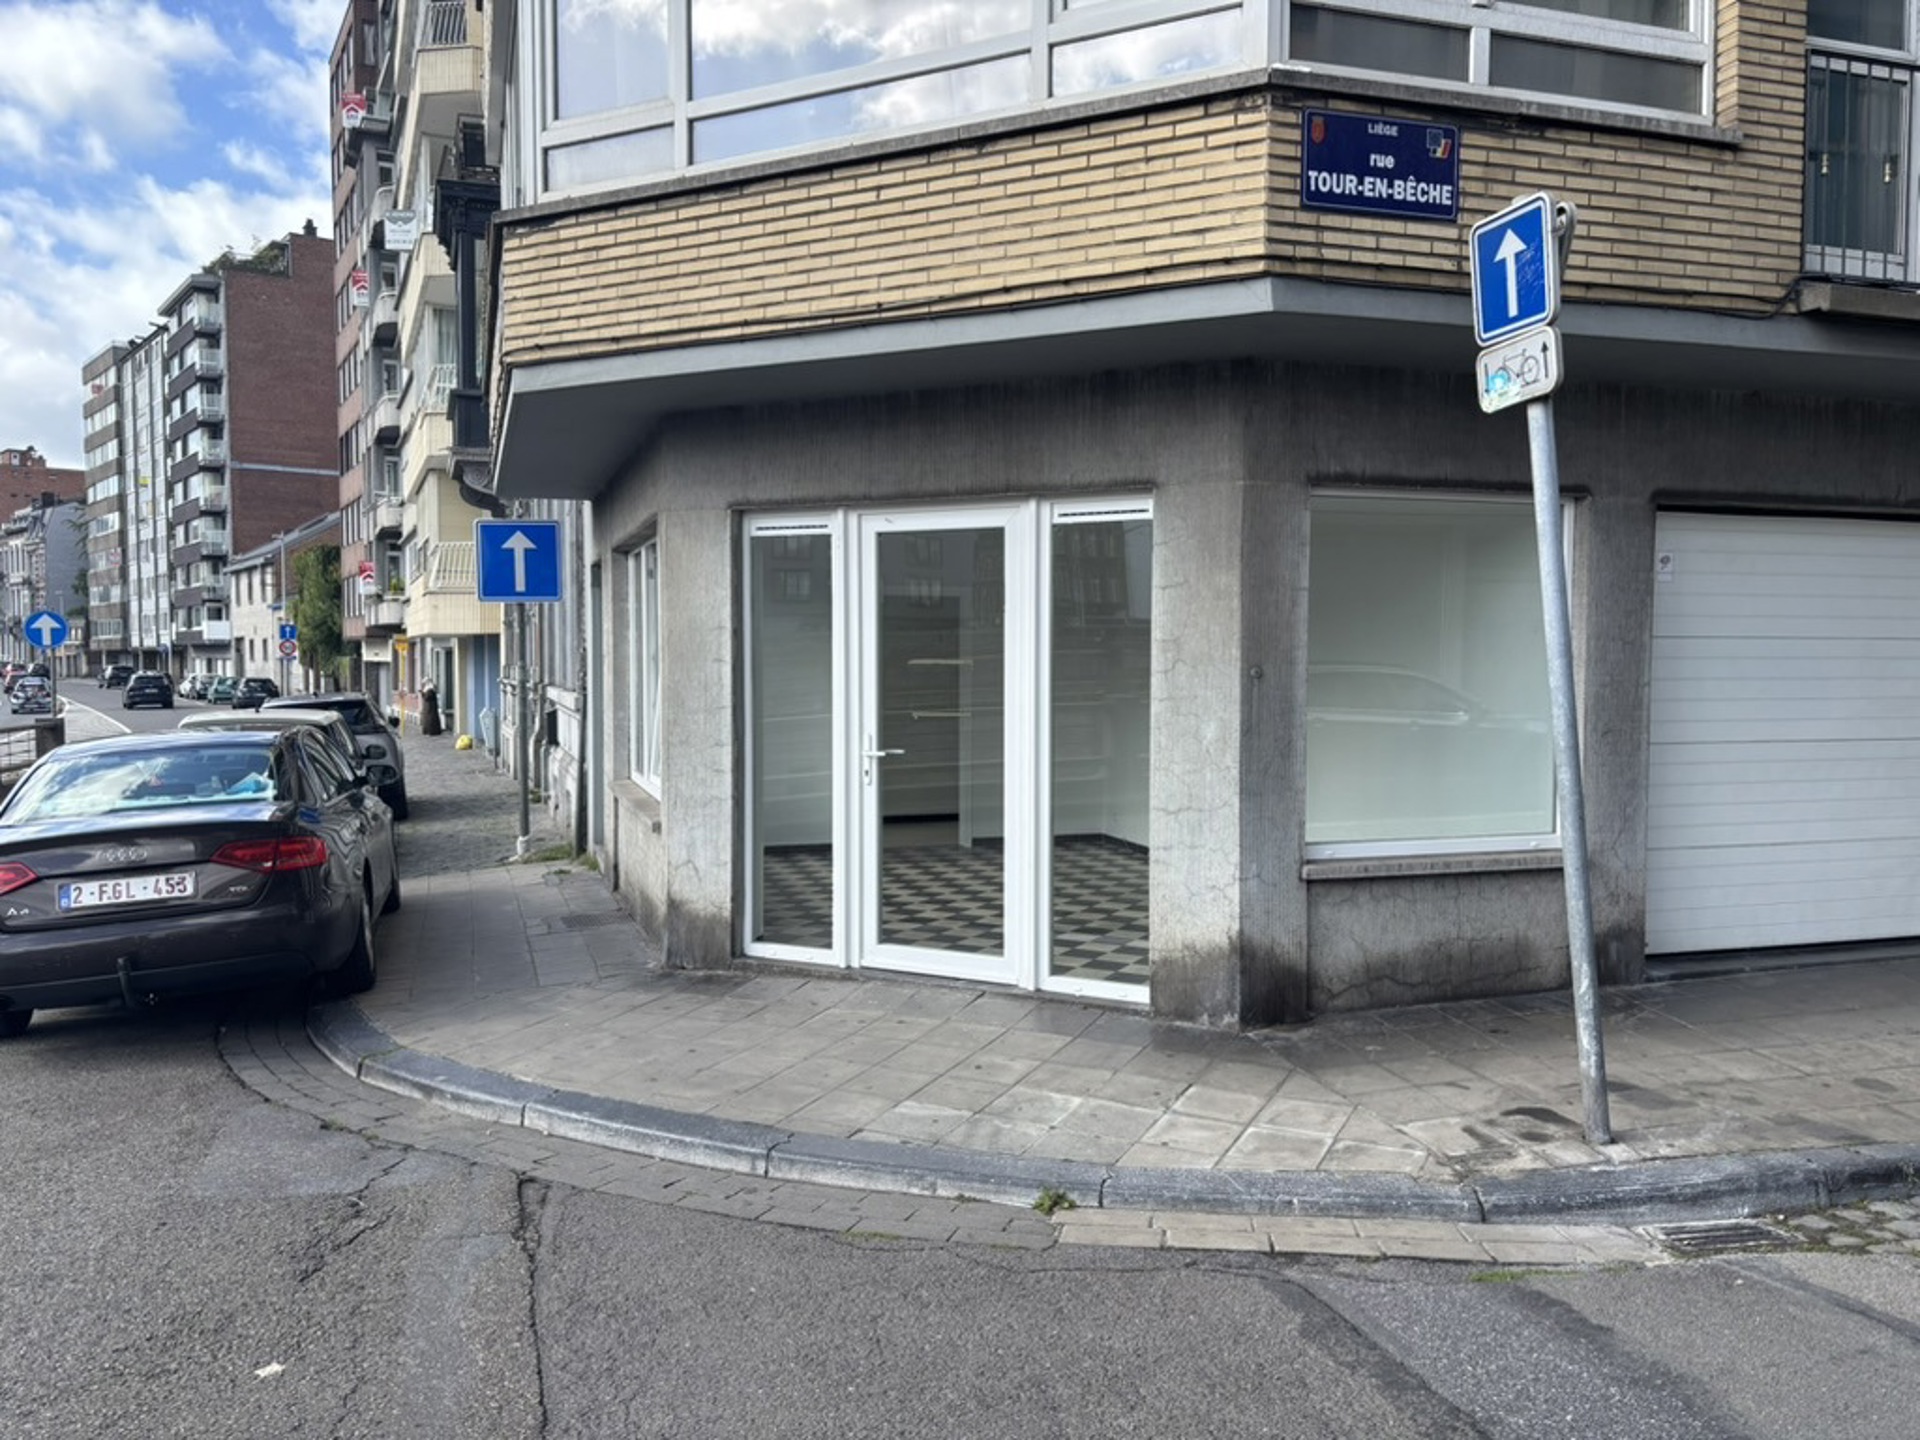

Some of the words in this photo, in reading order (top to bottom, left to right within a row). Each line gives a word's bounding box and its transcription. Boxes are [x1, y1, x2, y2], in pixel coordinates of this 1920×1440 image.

[1367, 121, 1399, 136] LIÈGE
[1369, 153, 1396, 169] rue
[1308, 169, 1453, 206] TOUR-EN-BÊCHE
